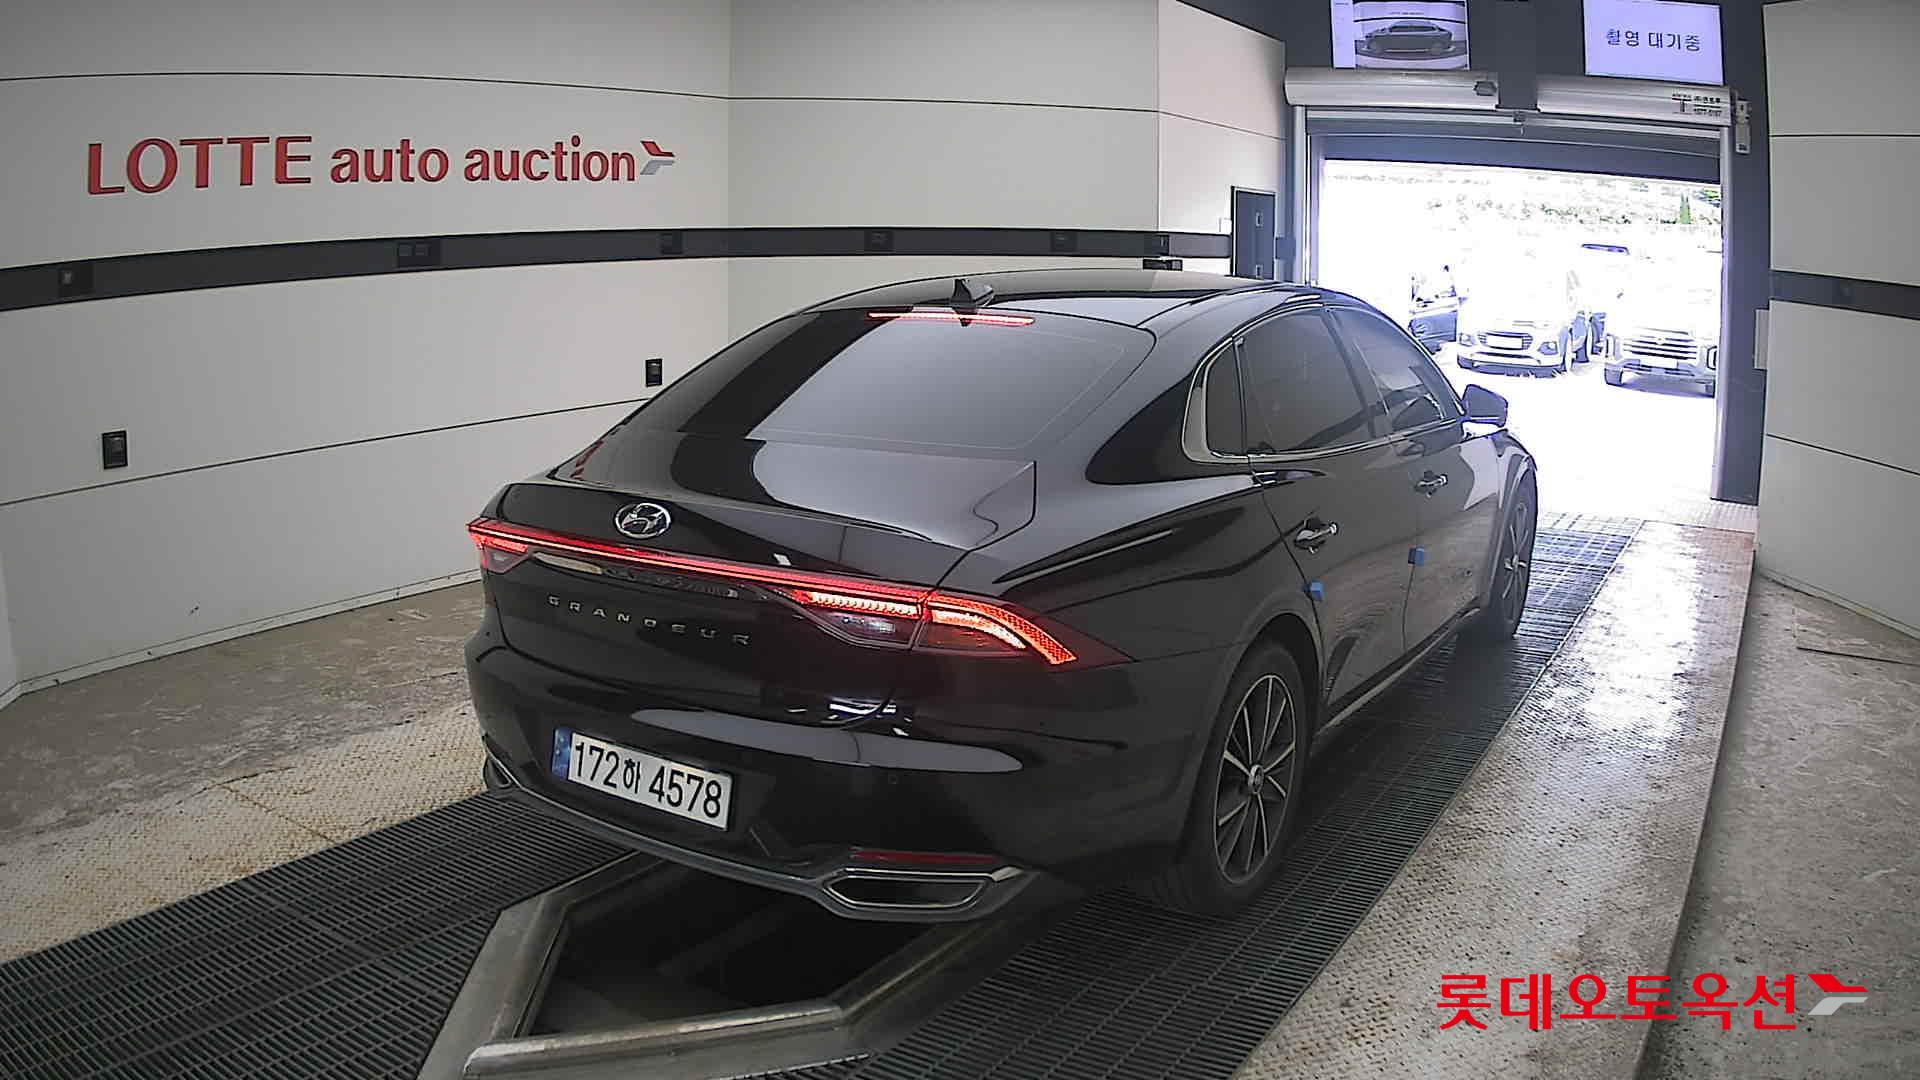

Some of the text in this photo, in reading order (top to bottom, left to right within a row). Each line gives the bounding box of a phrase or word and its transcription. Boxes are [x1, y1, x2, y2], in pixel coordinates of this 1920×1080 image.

[1647, 32, 1701, 51] 대기중
[87, 135, 636, 195] LOTTE auto auction
[548, 594, 751, 645] GRANDEUR
[575, 741, 722, 819] 172하 4578
